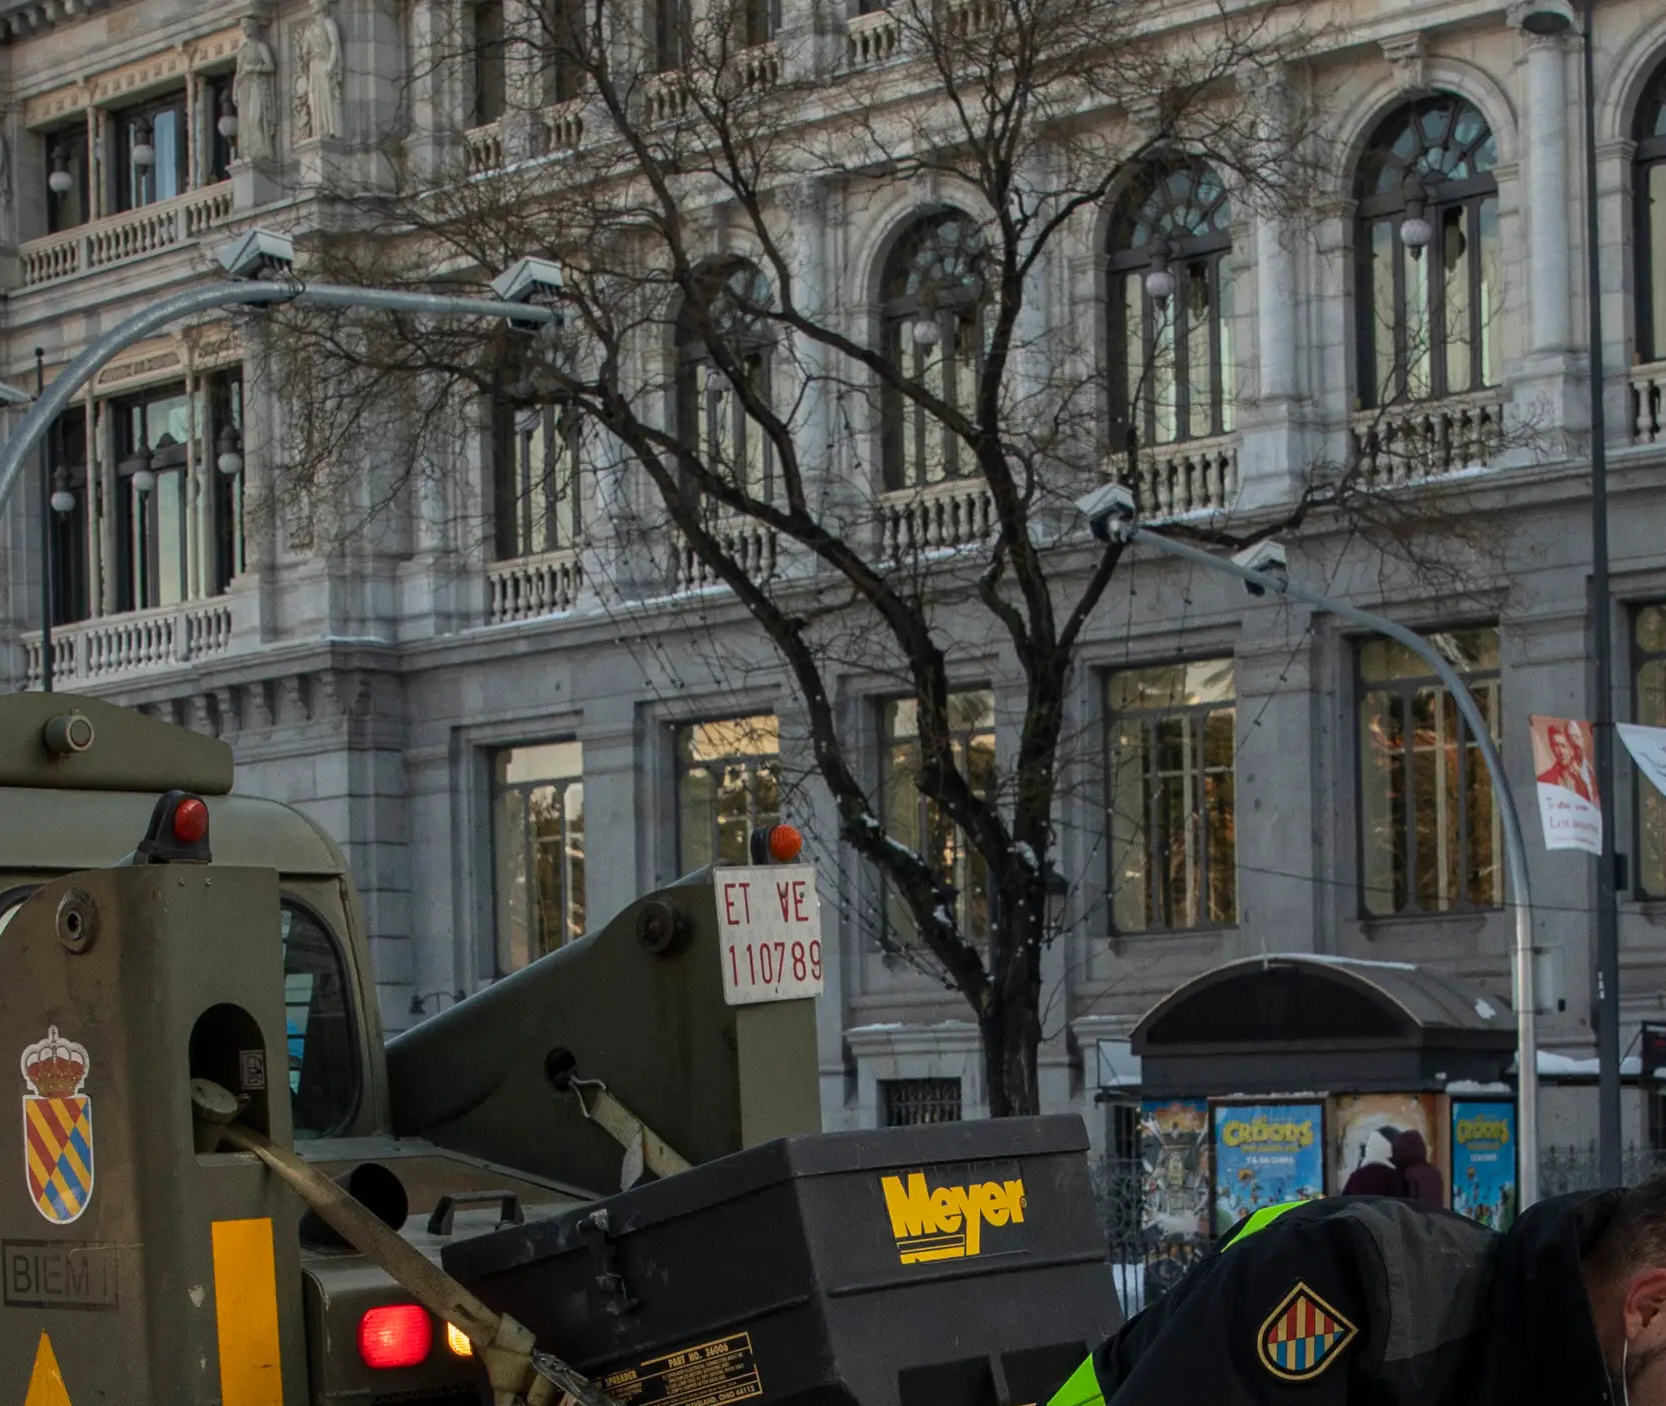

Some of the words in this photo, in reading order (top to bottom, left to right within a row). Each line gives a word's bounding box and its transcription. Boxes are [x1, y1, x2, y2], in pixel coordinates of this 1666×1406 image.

[724, 882, 751, 925] ET
[776, 881, 809, 923] VE
[729, 940, 821, 986] 110789
[881, 1172, 1024, 1256] Meyer
[12, 1254, 91, 1296] BIEM
[668, 1355, 685, 1368] PART
[688, 1351, 702, 1361] NO.
[719, 1391, 735, 1401] OHIO
[735, 1385, 754, 1396] 44112
